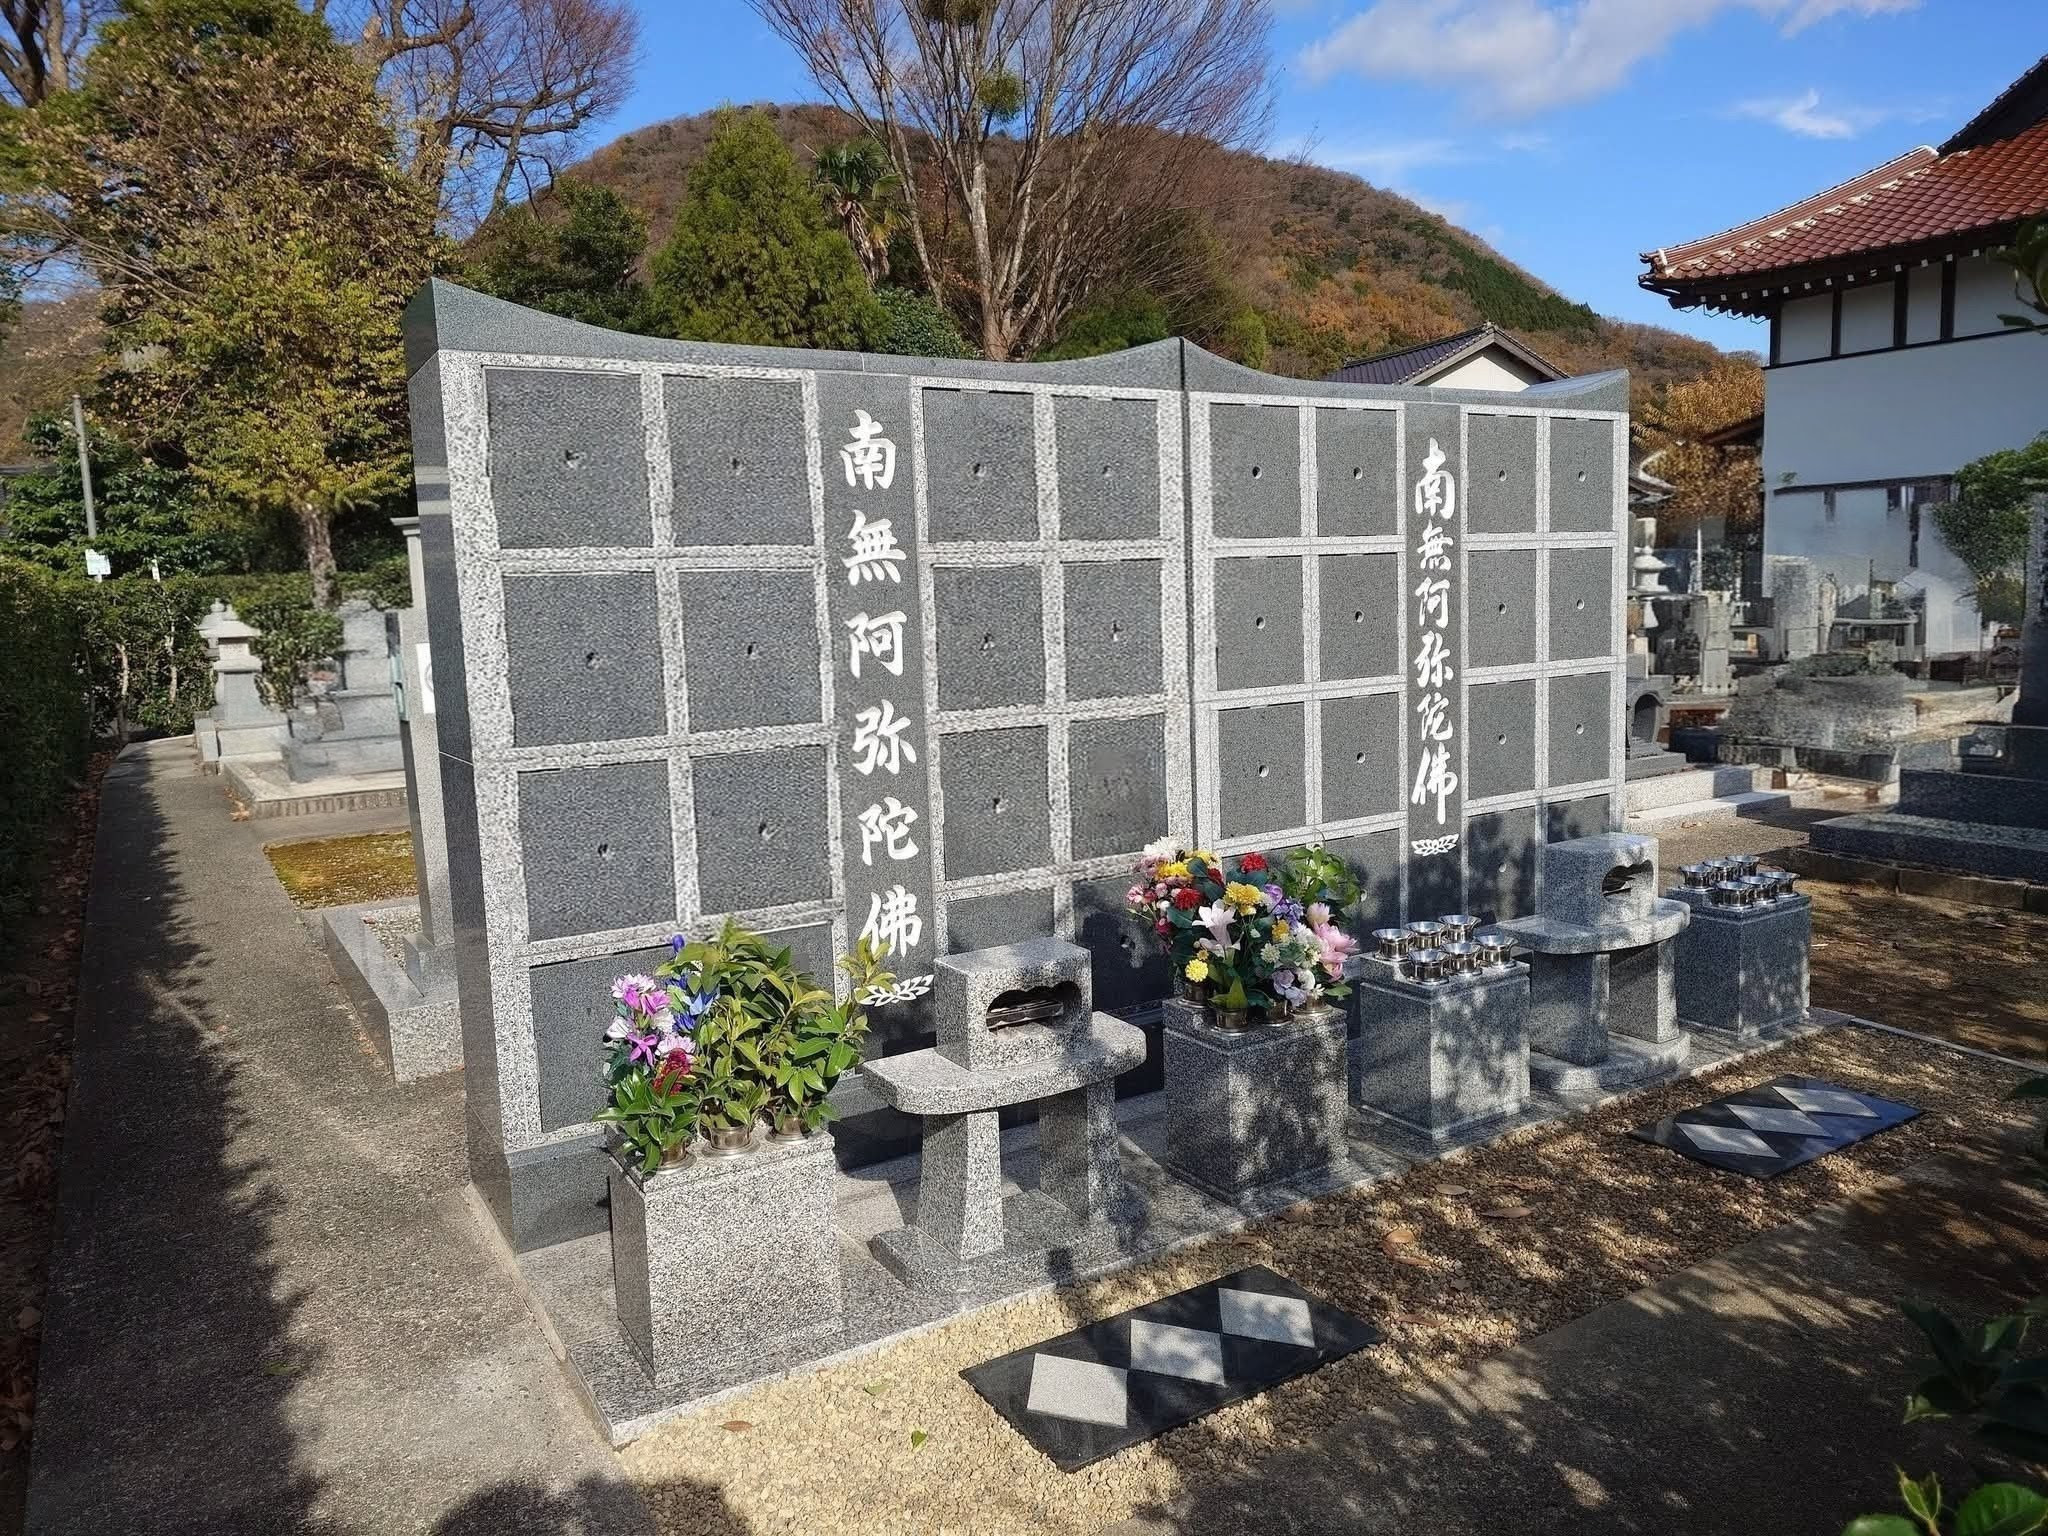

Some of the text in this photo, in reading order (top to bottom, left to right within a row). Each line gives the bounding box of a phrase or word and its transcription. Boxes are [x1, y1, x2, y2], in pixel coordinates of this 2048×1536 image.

[840, 409, 923, 958] 南無阿弥陀佛
[1411, 437, 1459, 825] 南無阿弥陀佛
